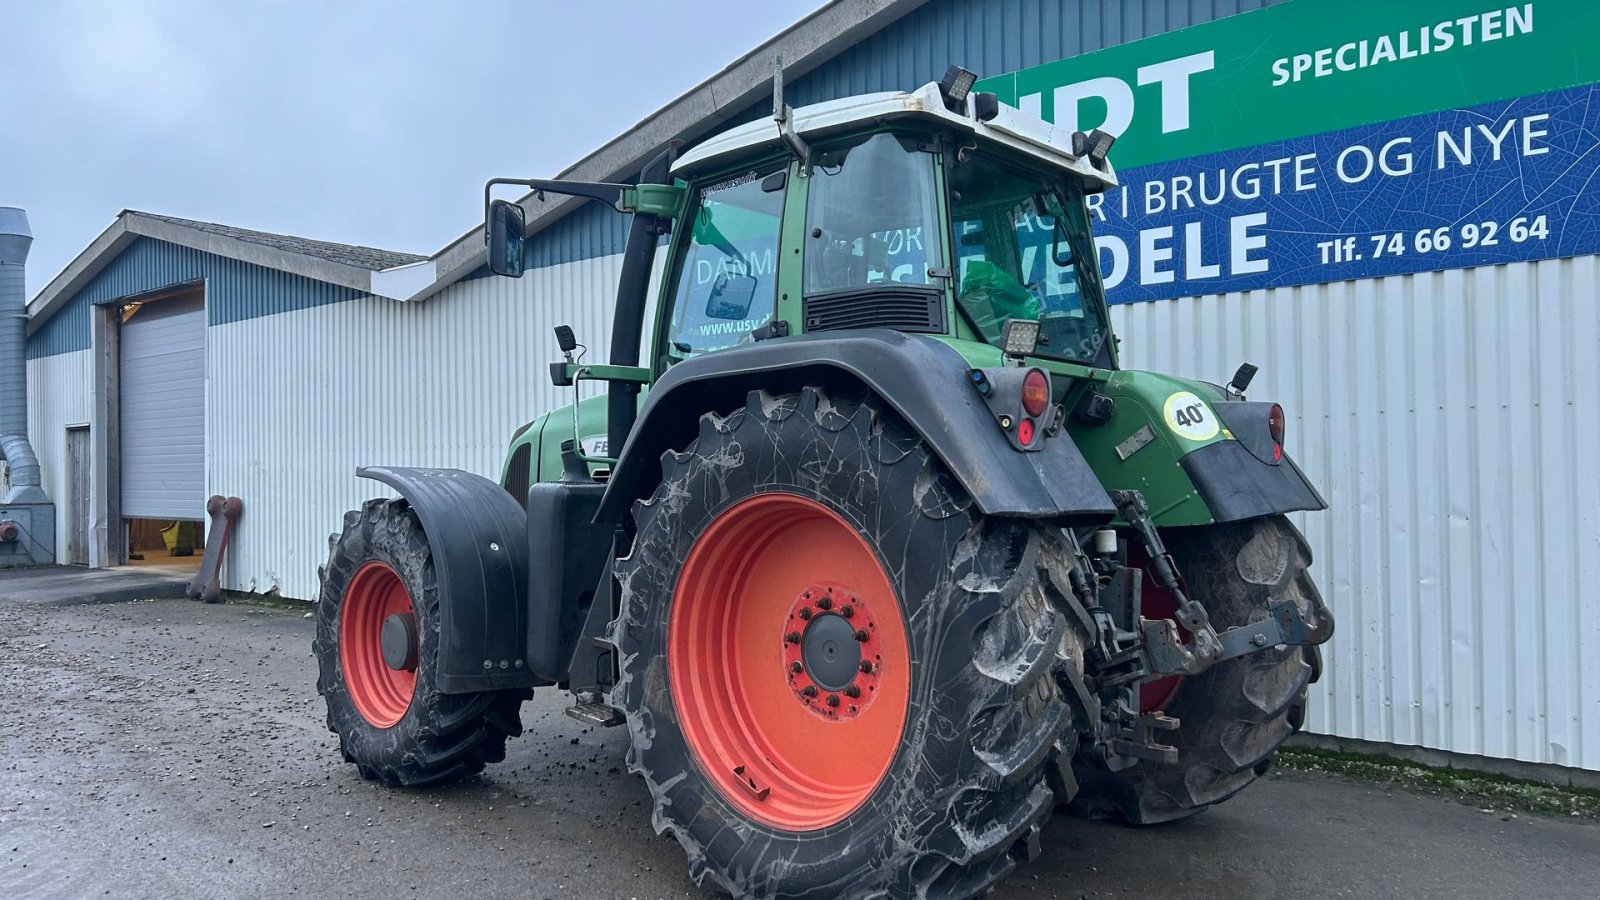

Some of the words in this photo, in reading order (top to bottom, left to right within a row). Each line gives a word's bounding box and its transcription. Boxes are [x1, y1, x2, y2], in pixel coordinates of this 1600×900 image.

[1271, 2, 1534, 88] SPECIALISTEN
[696, 248, 777, 285] DANM
[1145, 153, 1317, 215] BRUGTE
[1336, 136, 1413, 184] OG
[1437, 113, 1550, 170] NYE
[1317, 236, 1363, 265] Tlf.
[1371, 232, 1406, 259] 74
[1414, 226, 1451, 253] 66
[1461, 221, 1499, 248] 92
[1509, 215, 1550, 243] 64
[1176, 405, 1204, 427] 40
[592, 440, 609, 453] FE
